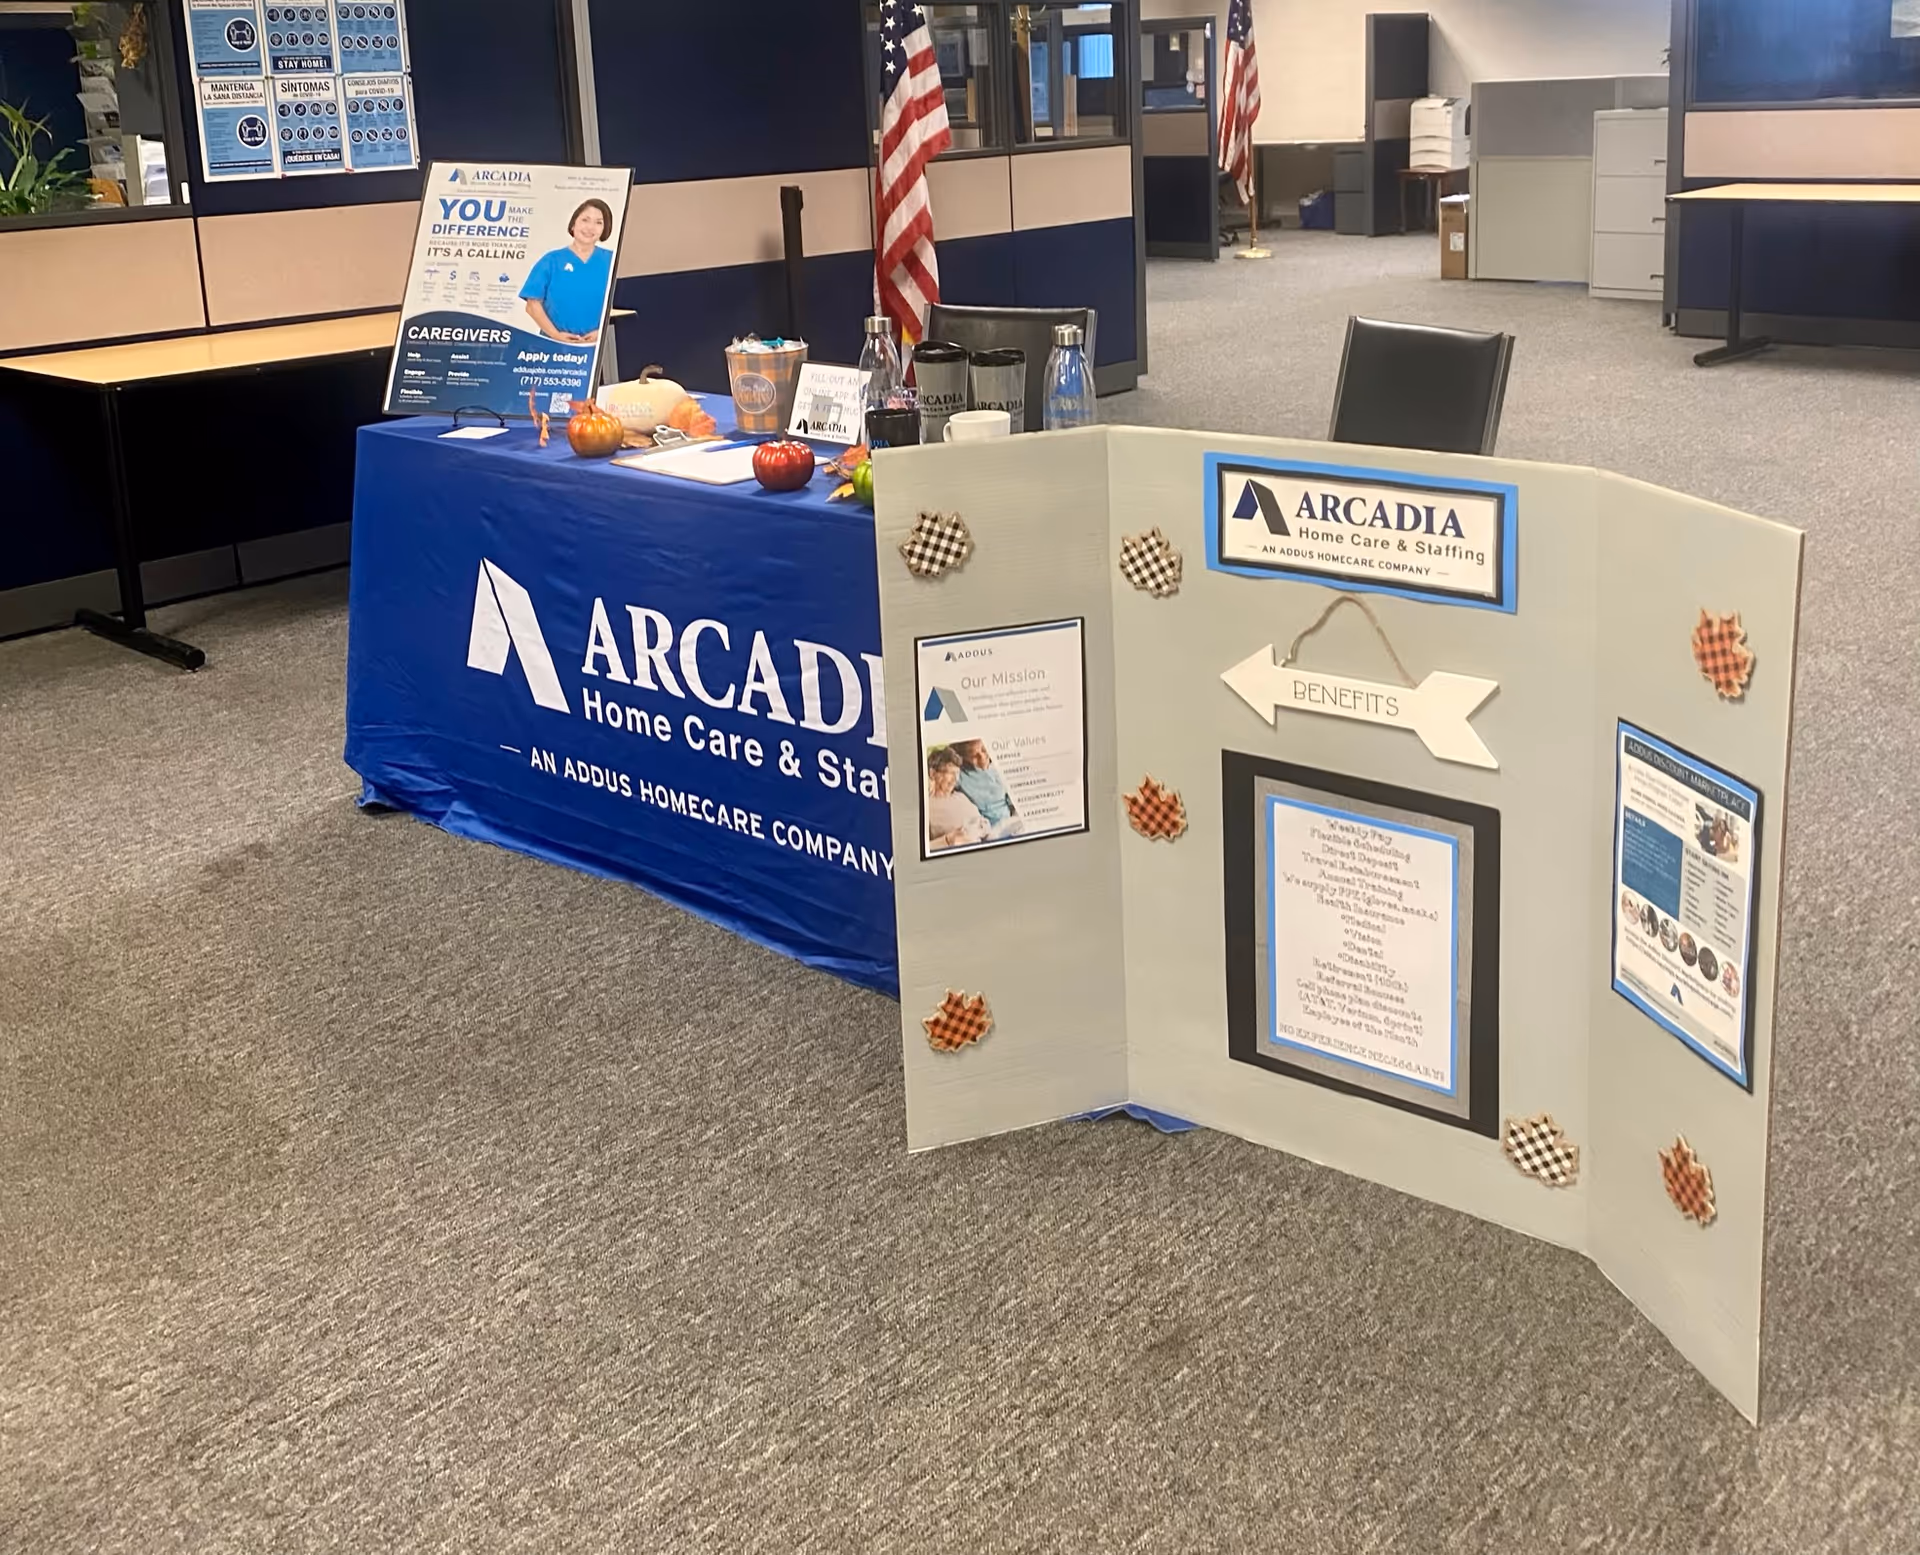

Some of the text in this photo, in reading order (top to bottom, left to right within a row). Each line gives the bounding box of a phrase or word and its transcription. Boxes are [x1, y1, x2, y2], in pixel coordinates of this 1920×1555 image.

[302, 60, 327, 68] HOME!
[211, 83, 254, 92] MANTENGA
[281, 80, 330, 92] SÍNTOMAS
[472, 170, 531, 182] ARCADIA
[439, 199, 506, 222] YOU
[432, 224, 529, 237] DIFFERENCE
[427, 248, 525, 259] IT'S A CALLING
[408, 326, 511, 343] CAREGIVERS
[517, 351, 550, 363] Apply
[553, 353, 588, 364] today!
[520, 376, 541, 386] (717)
[810, 421, 846, 433] ARCADIA
[1295, 490, 1465, 539] ARCADIA
[1299, 527, 1485, 565] Home Care & Staffing
[1262, 545, 1431, 576] AN ADDUS HOMECARE COMPANY
[958, 648, 993, 659] ADDUS
[961, 669, 1045, 690] Our Mission
[1293, 680, 1399, 717] BENEFITS
[582, 687, 671, 742] Home
[683, 715, 763, 768] Care
[778, 739, 802, 779] &
[992, 736, 1046, 750] Our Values
[1628, 741, 1745, 811] ADDUS DISCOUNT MARKETPLACE
[530, 747, 895, 881] AN ADDUS HOMECARE COMPANY
[1310, 828, 1411, 862] Flexible Scheduling
[1302, 852, 1337, 868] Travel
[1321, 844, 1398, 872] Direct Deposit
